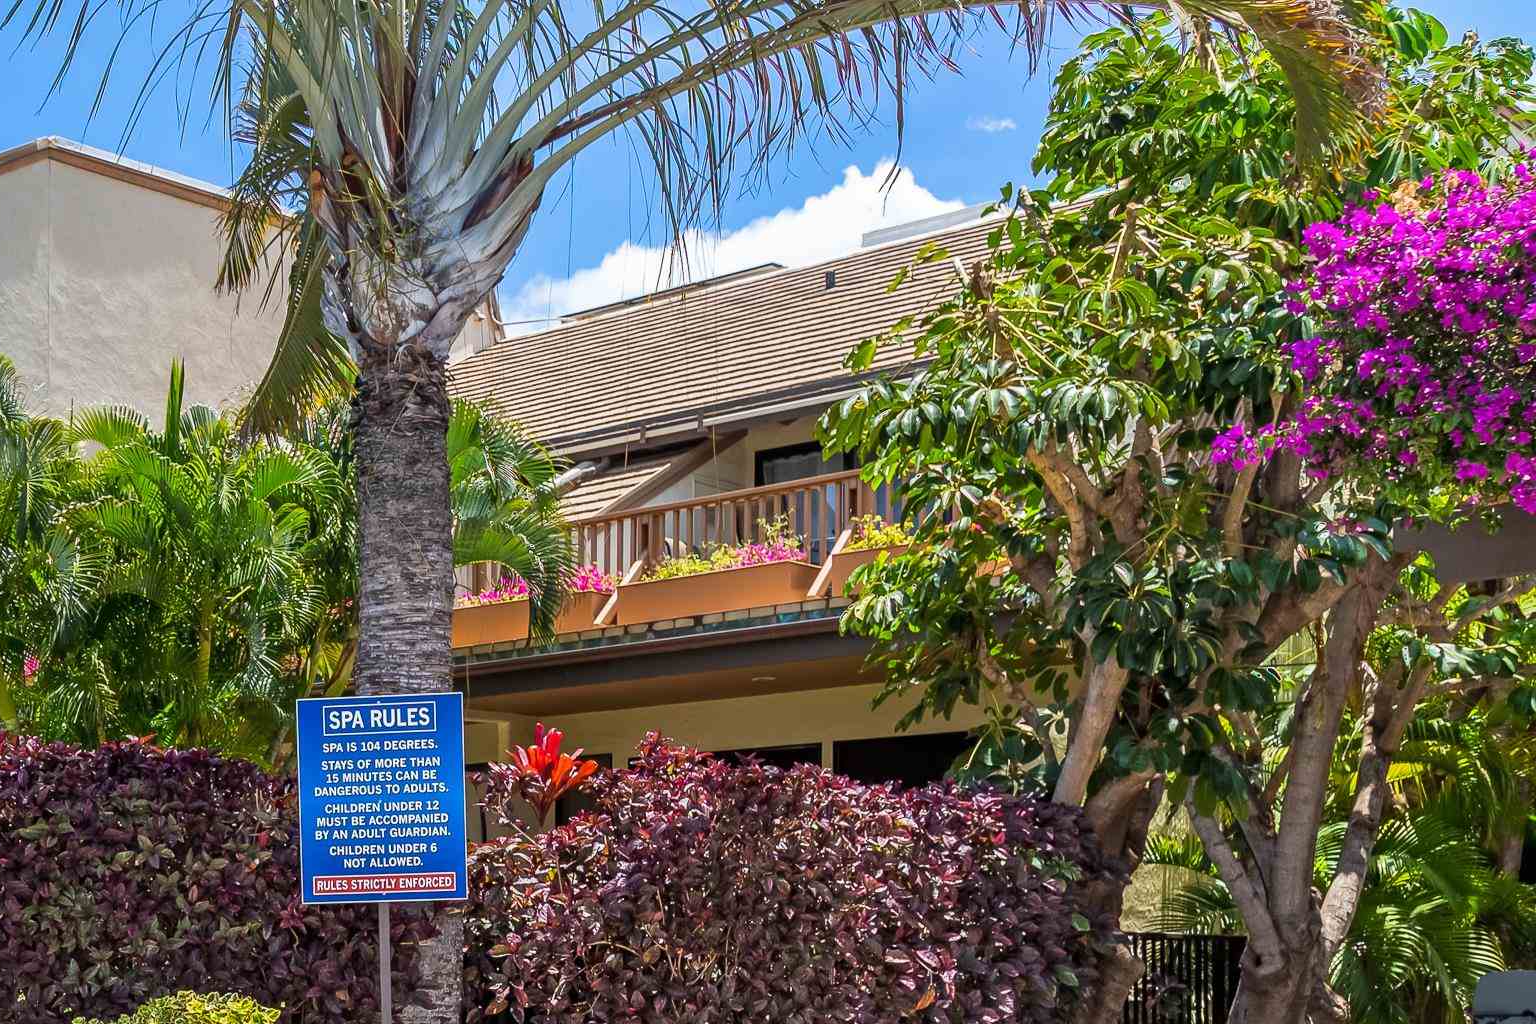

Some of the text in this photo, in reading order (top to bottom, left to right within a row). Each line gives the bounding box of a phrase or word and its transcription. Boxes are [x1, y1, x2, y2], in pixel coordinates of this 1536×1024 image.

[329, 707, 429, 729] SPA RULES
[323, 739, 437, 752] SPA IS 104 DEGREES.
[322, 757, 440, 770] STAYS OF MORE THAN
[327, 770, 436, 783] 15 MINUTES CAN BE
[315, 783, 448, 796] DANGEROUS TO ADULTS.
[325, 800, 439, 814] CHILDREN UNDER 12
[317, 813, 448, 827] MUST BE ACCOMPANIED
[315, 826, 450, 840] BY AN ADULT GUARDIAN.
[330, 843, 437, 855] CHILDREN UNDER 6
[344, 857, 423, 868] NOT ALLOWED.
[317, 877, 451, 891] RULES STRICTLY ENFORCED
